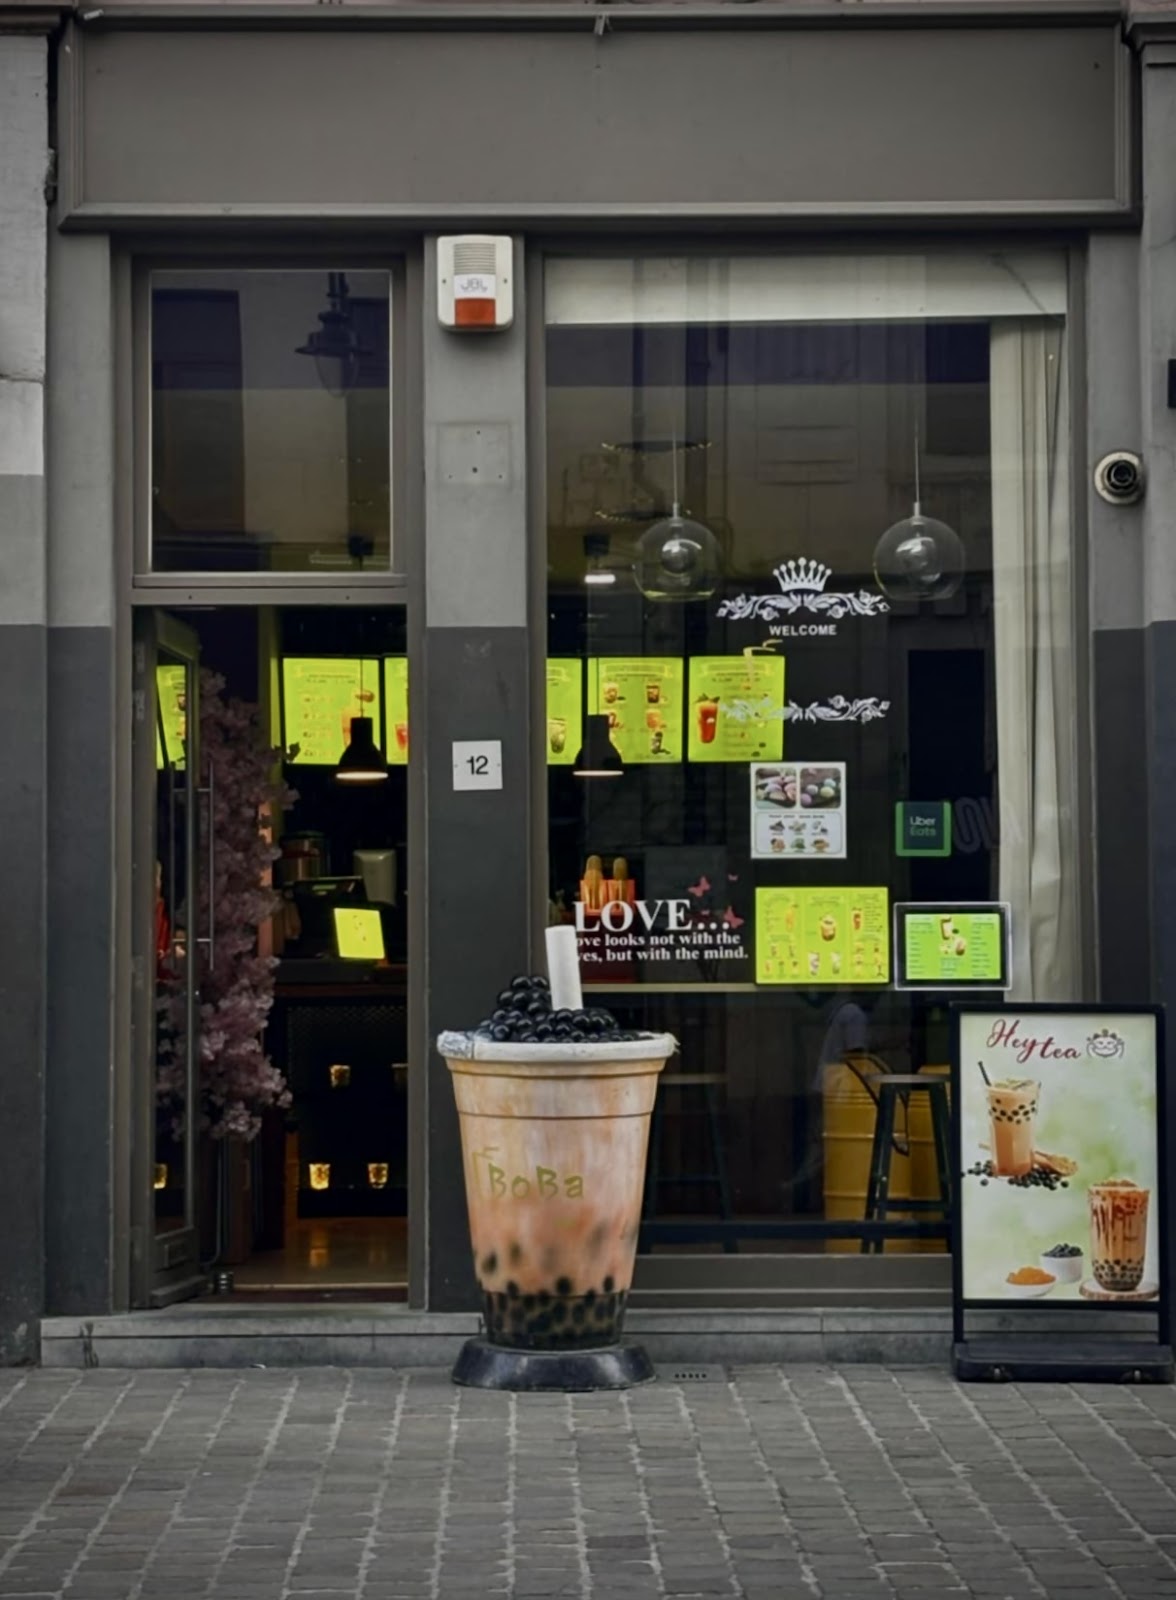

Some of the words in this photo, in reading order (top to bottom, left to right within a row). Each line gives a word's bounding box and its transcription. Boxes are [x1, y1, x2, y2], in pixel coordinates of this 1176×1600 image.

[769, 624, 838, 637] WELCOME
[466, 755, 489, 775] 12
[910, 816, 937, 826] Uber
[577, 936, 601, 947] ove
[605, 934, 646, 947] looks
[650, 934, 675, 946] not
[679, 932, 713, 945] with
[717, 932, 740, 944] the
[606, 949, 632, 962] but
[637, 949, 671, 961] with
[675, 947, 700, 960] the
[703, 946, 749, 960] mind.
[488, 1162, 583, 1199] BoBa
